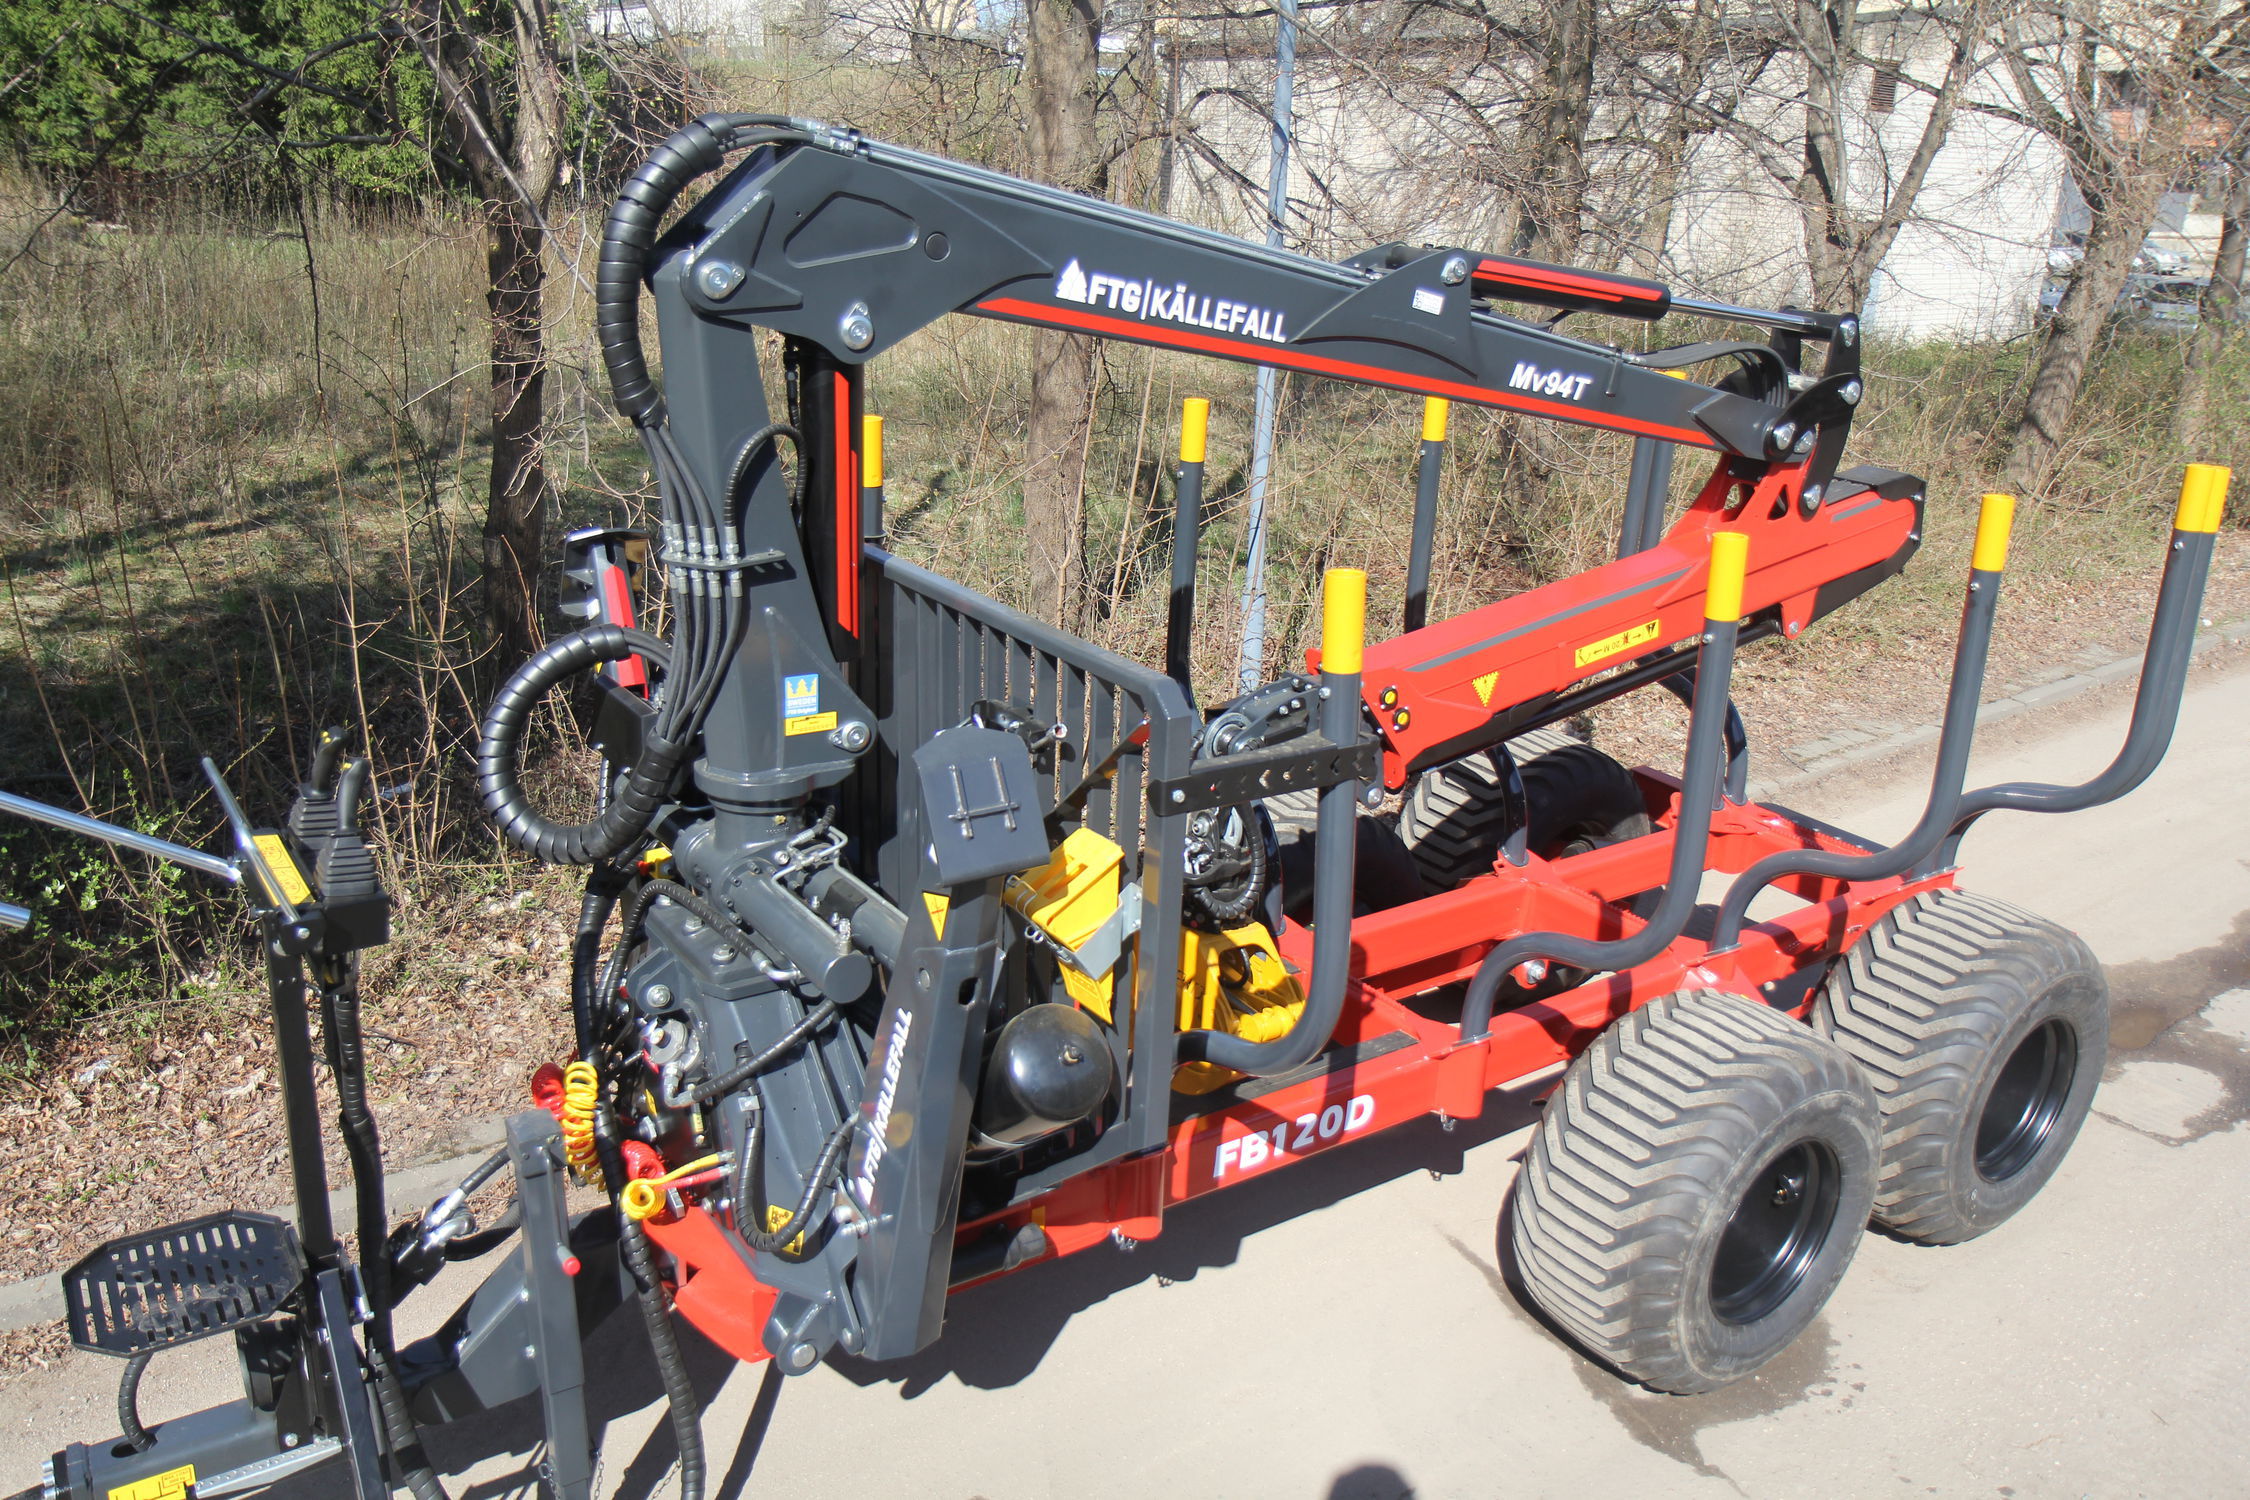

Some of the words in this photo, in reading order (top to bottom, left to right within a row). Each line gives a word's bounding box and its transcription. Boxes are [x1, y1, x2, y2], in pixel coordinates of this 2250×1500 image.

[1149, 284, 1287, 344] KÄLLEFALL
[1508, 362, 1593, 401] Mv94T
[1213, 1094, 1375, 1178] FB120D
